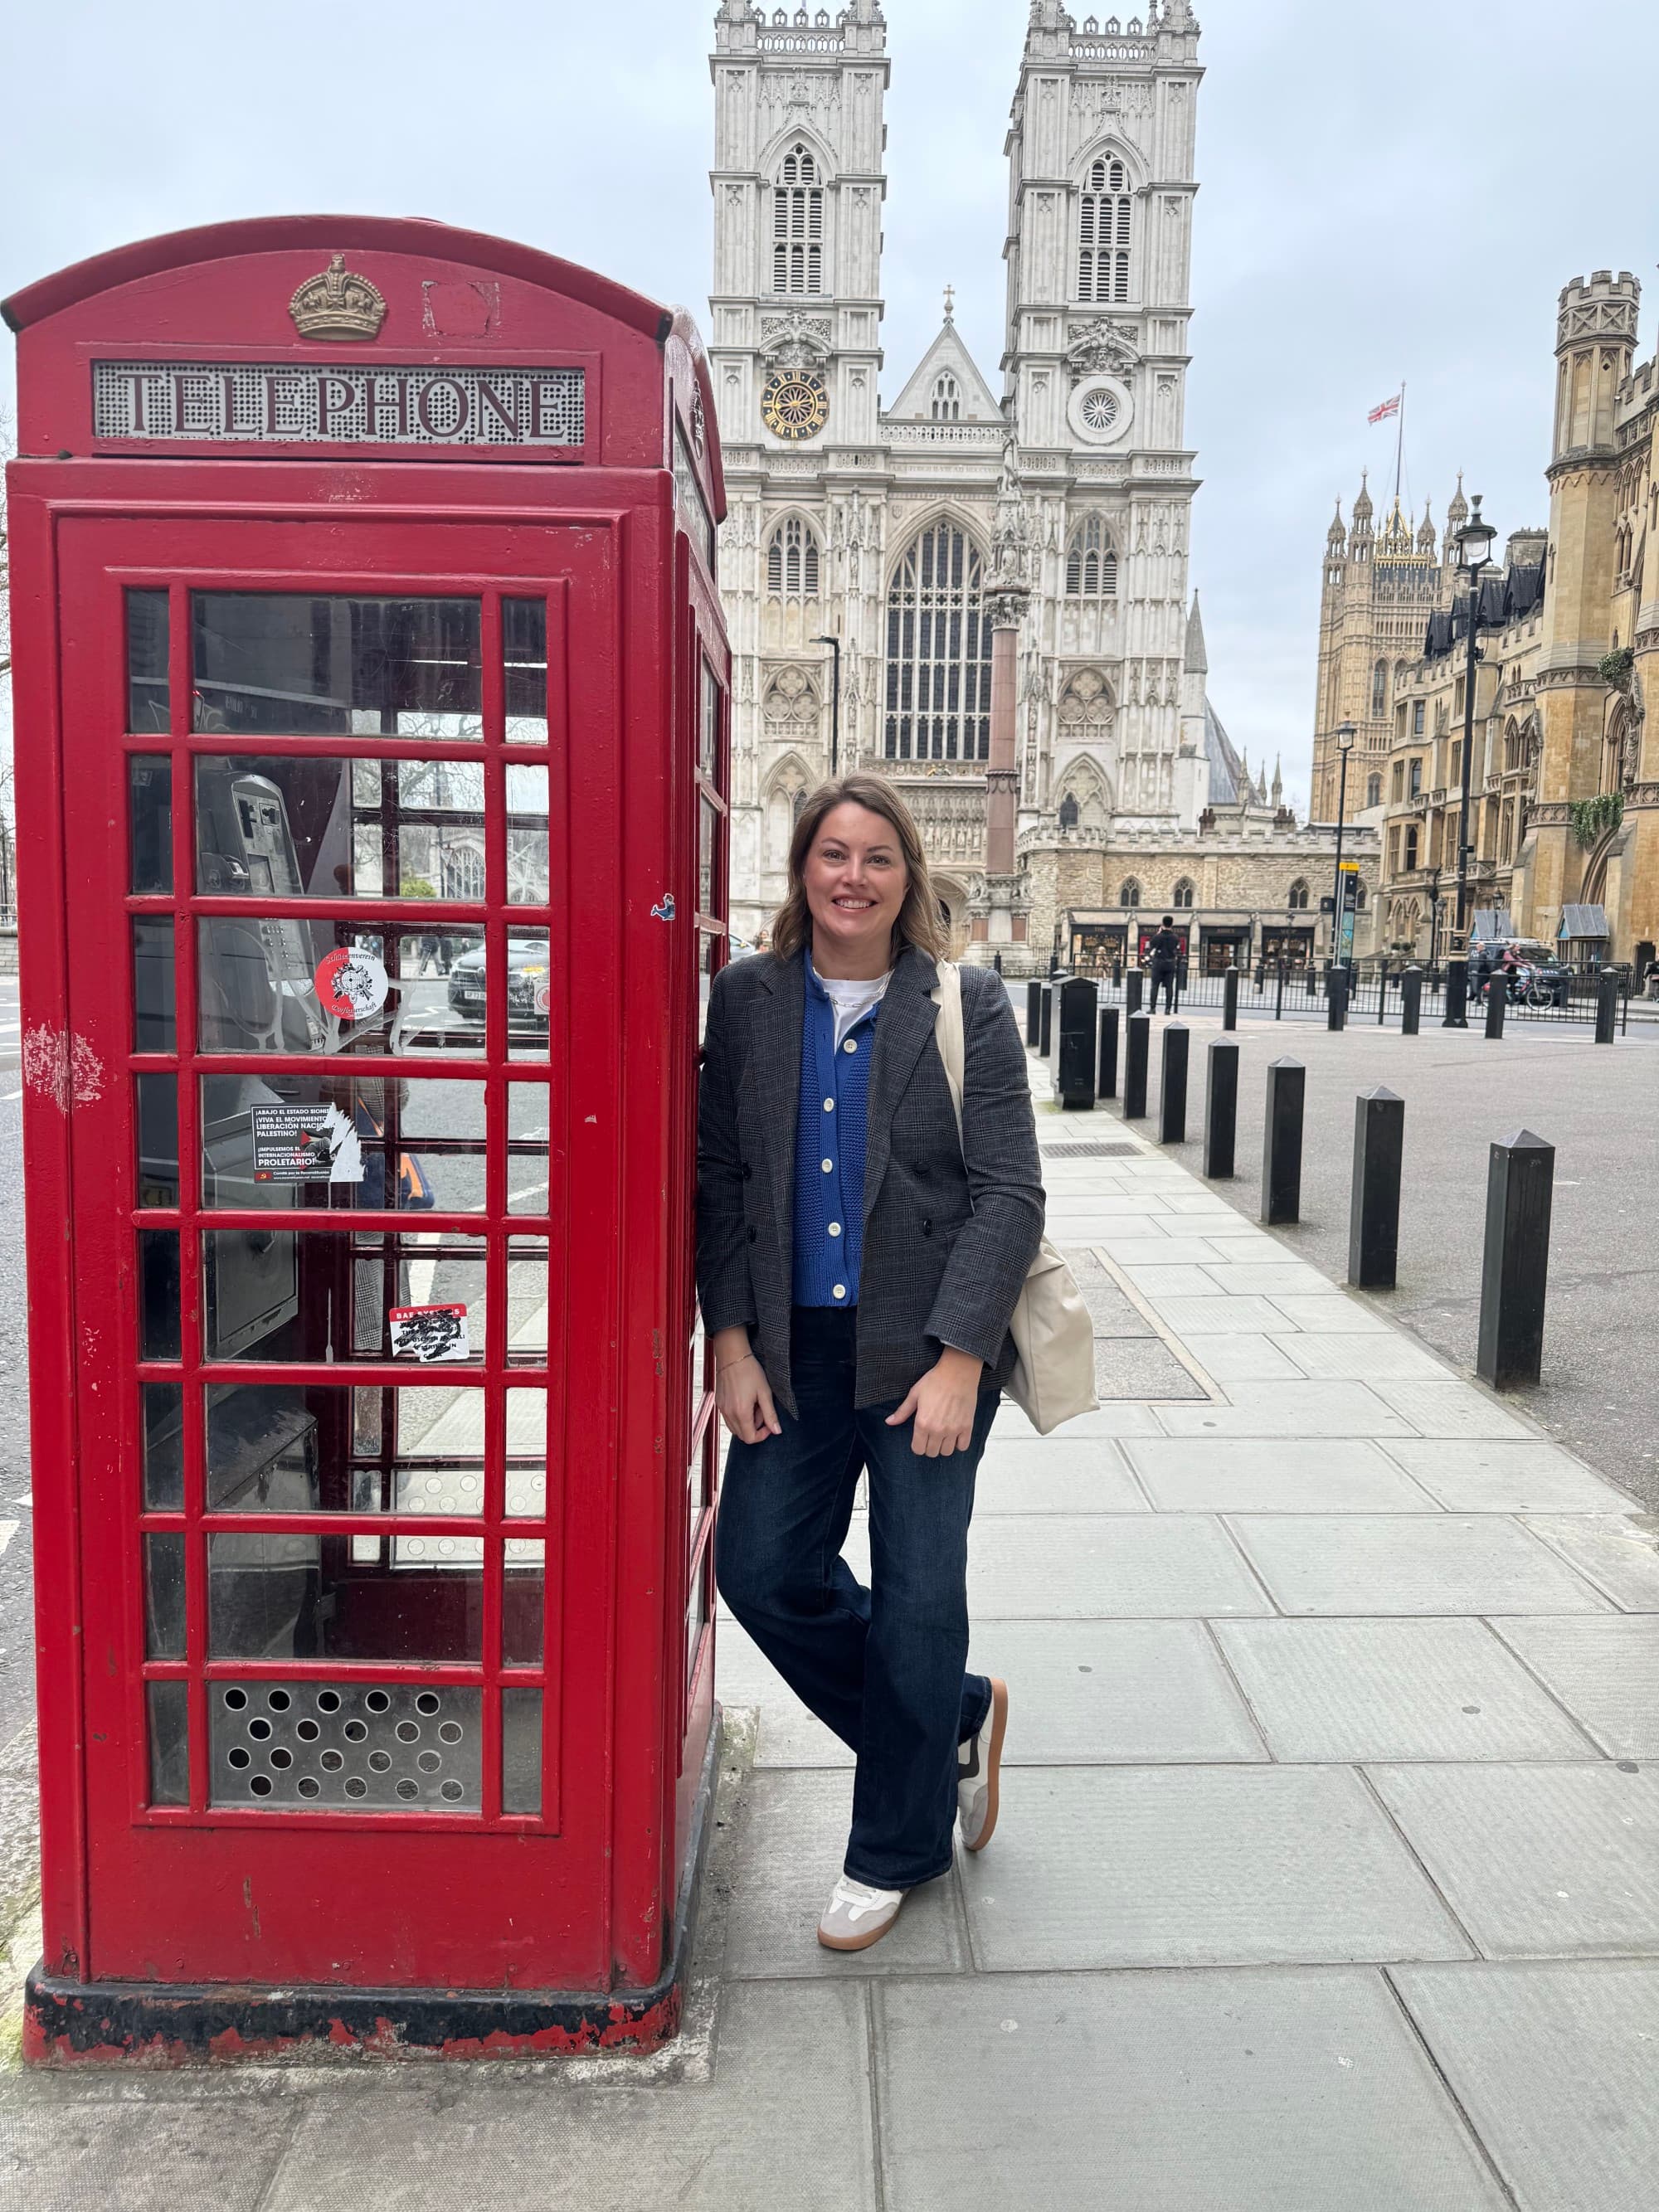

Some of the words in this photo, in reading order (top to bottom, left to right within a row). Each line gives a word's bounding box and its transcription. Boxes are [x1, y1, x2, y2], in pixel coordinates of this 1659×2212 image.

[117, 373, 566, 438] TELEPHONE
[256, 1121, 299, 1130] LIBERACIÓN
[258, 1158, 315, 1166] PROLETARIO!
